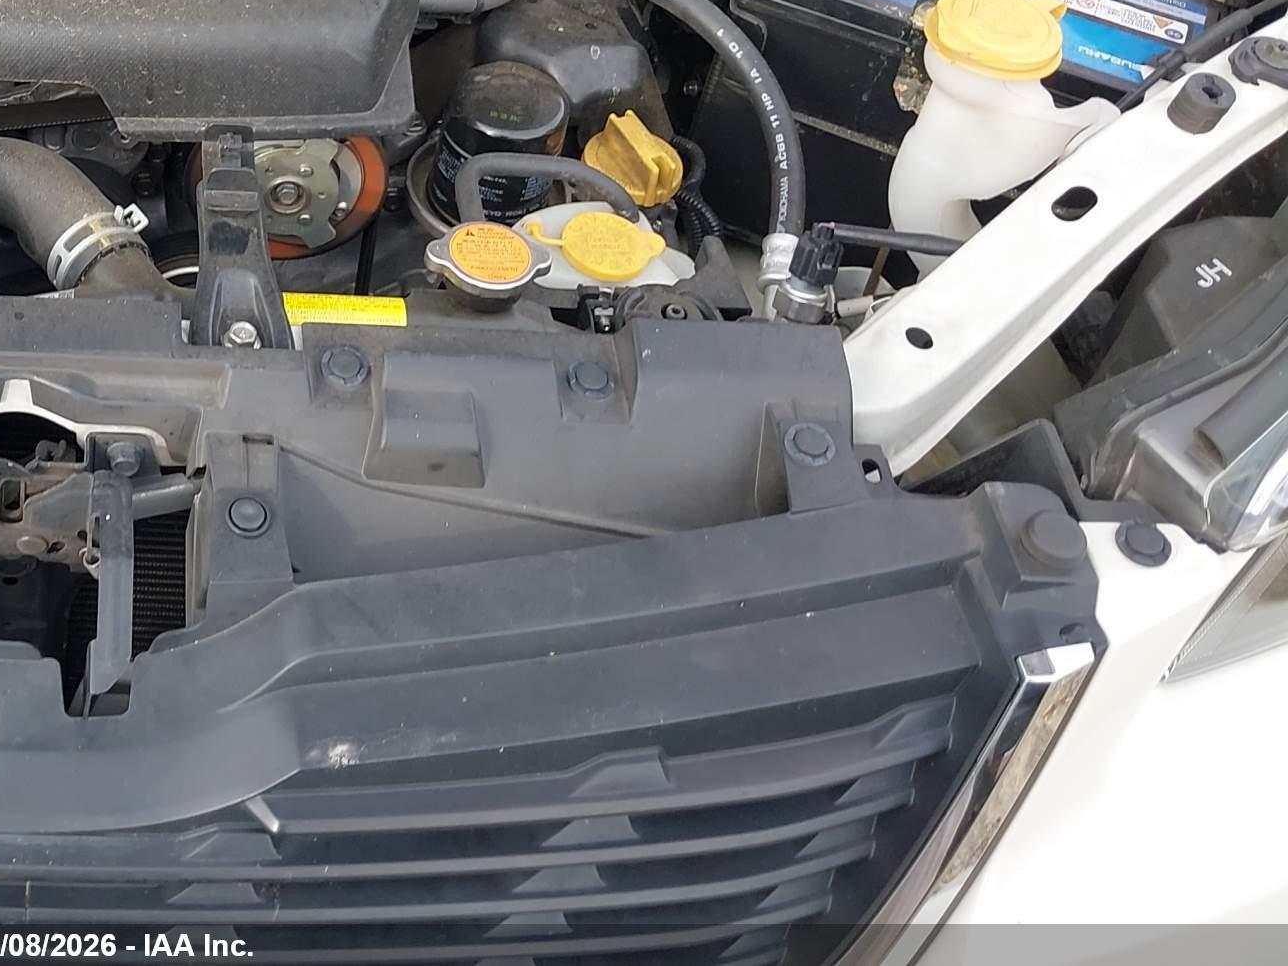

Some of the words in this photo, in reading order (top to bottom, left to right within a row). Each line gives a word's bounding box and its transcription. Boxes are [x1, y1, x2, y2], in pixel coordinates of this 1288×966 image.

[761, 92, 775, 111] HP
[770, 114, 780, 128] 11
[1195, 258, 1233, 288] JH
